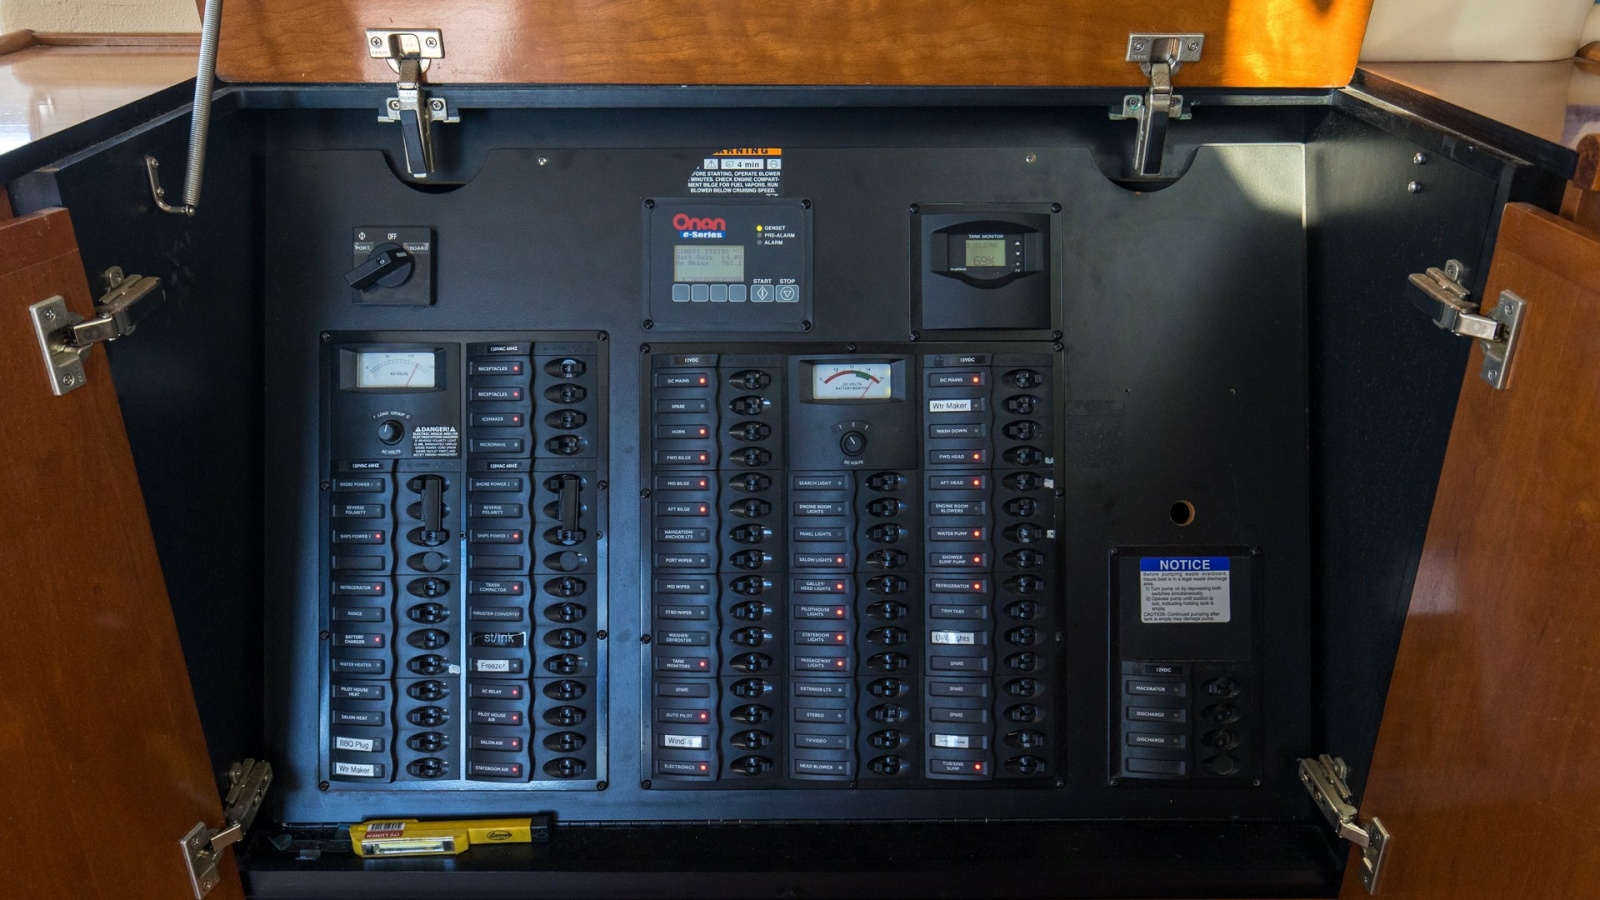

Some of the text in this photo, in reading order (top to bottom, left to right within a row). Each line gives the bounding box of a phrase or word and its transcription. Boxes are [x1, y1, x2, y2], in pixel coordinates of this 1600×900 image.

[673, 213, 726, 231] Onan
[973, 256, 995, 266] 69%
[1160, 560, 1210, 570] NOTICE
[340, 740, 369, 750] BBQ Plug
[350, 766, 370, 774] Maker
